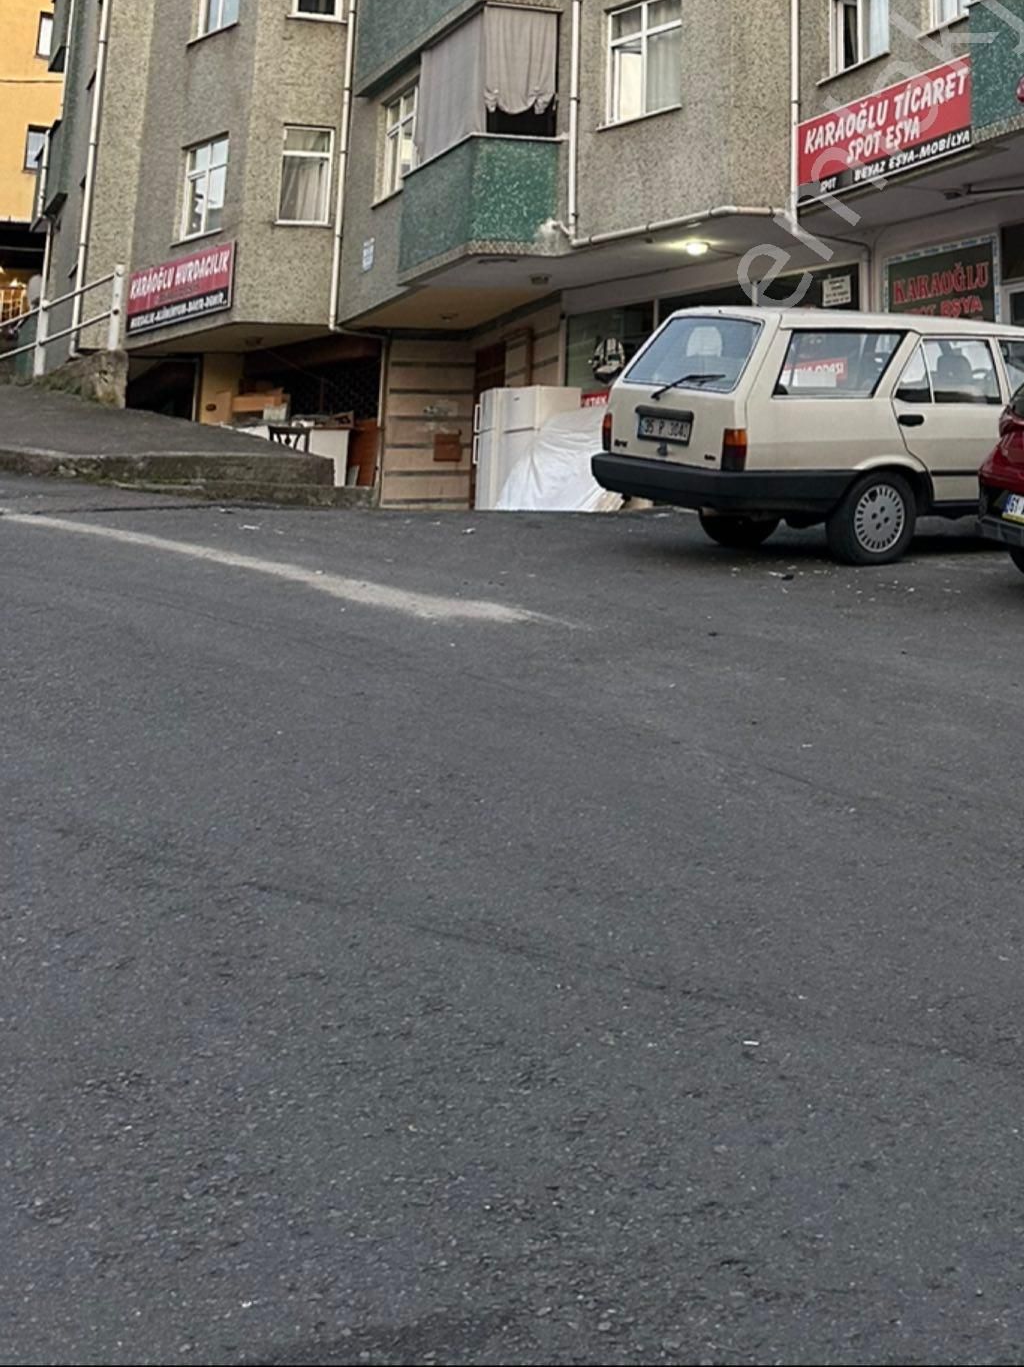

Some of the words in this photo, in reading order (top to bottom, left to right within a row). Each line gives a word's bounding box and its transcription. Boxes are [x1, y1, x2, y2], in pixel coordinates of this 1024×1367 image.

[804, 100, 889, 155] KARAOĞLU
[894, 67, 969, 121] TİCARET
[847, 132, 884, 164] SPOT
[885, 116, 921, 151] EŞYA
[854, 159, 886, 182] BEYAZ
[893, 261, 989, 305] KARAOĞLU
[1009, 496, 1020, 513] 61
